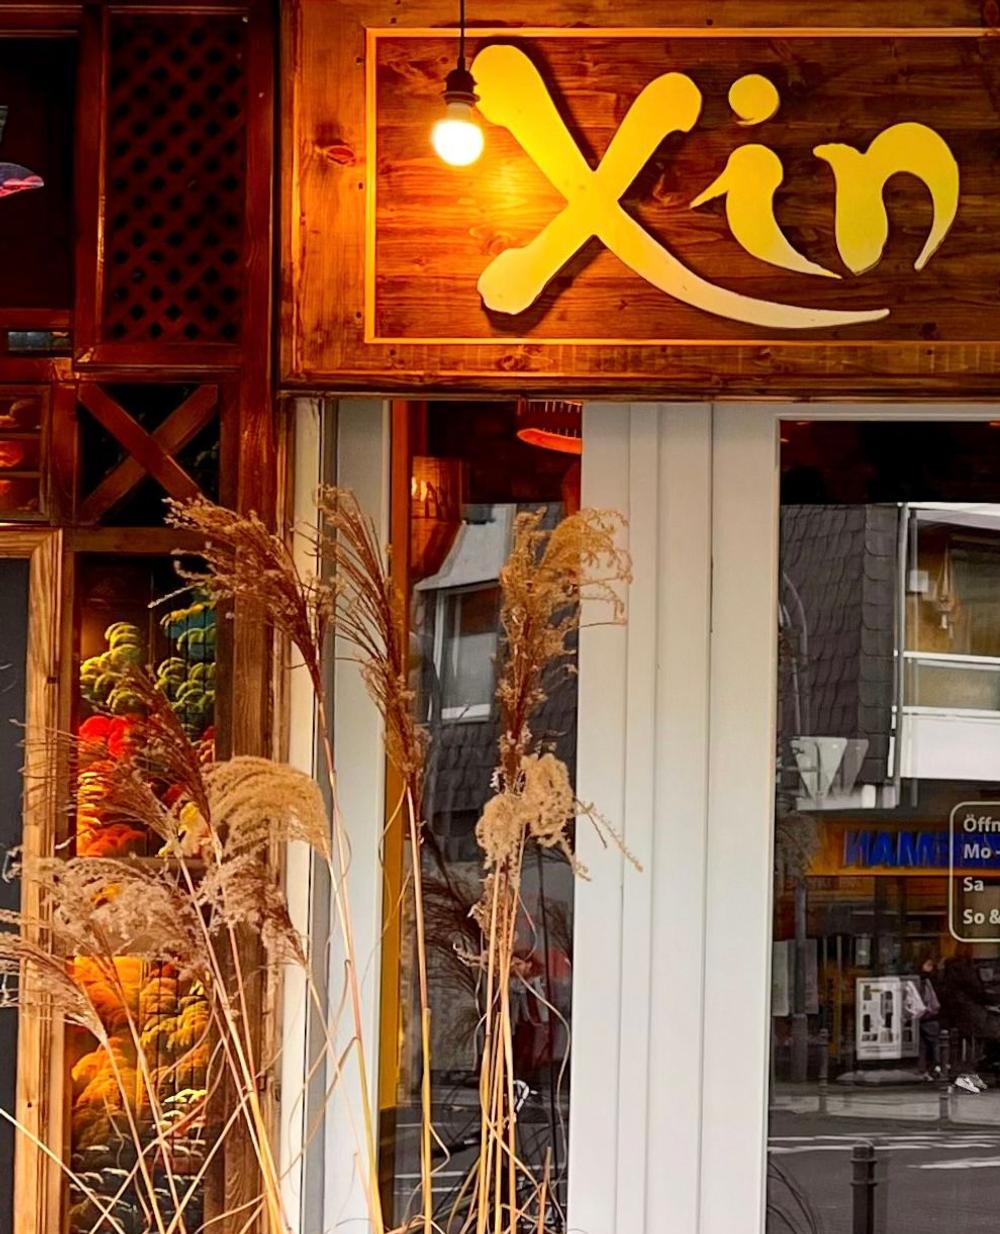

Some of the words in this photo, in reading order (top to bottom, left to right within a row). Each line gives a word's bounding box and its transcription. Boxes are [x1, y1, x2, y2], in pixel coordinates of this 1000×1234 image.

[470, 44, 960, 328] Xin
[963, 843, 991, 859] Mo
[963, 877, 984, 892] Sa
[963, 909, 985, 924] So
